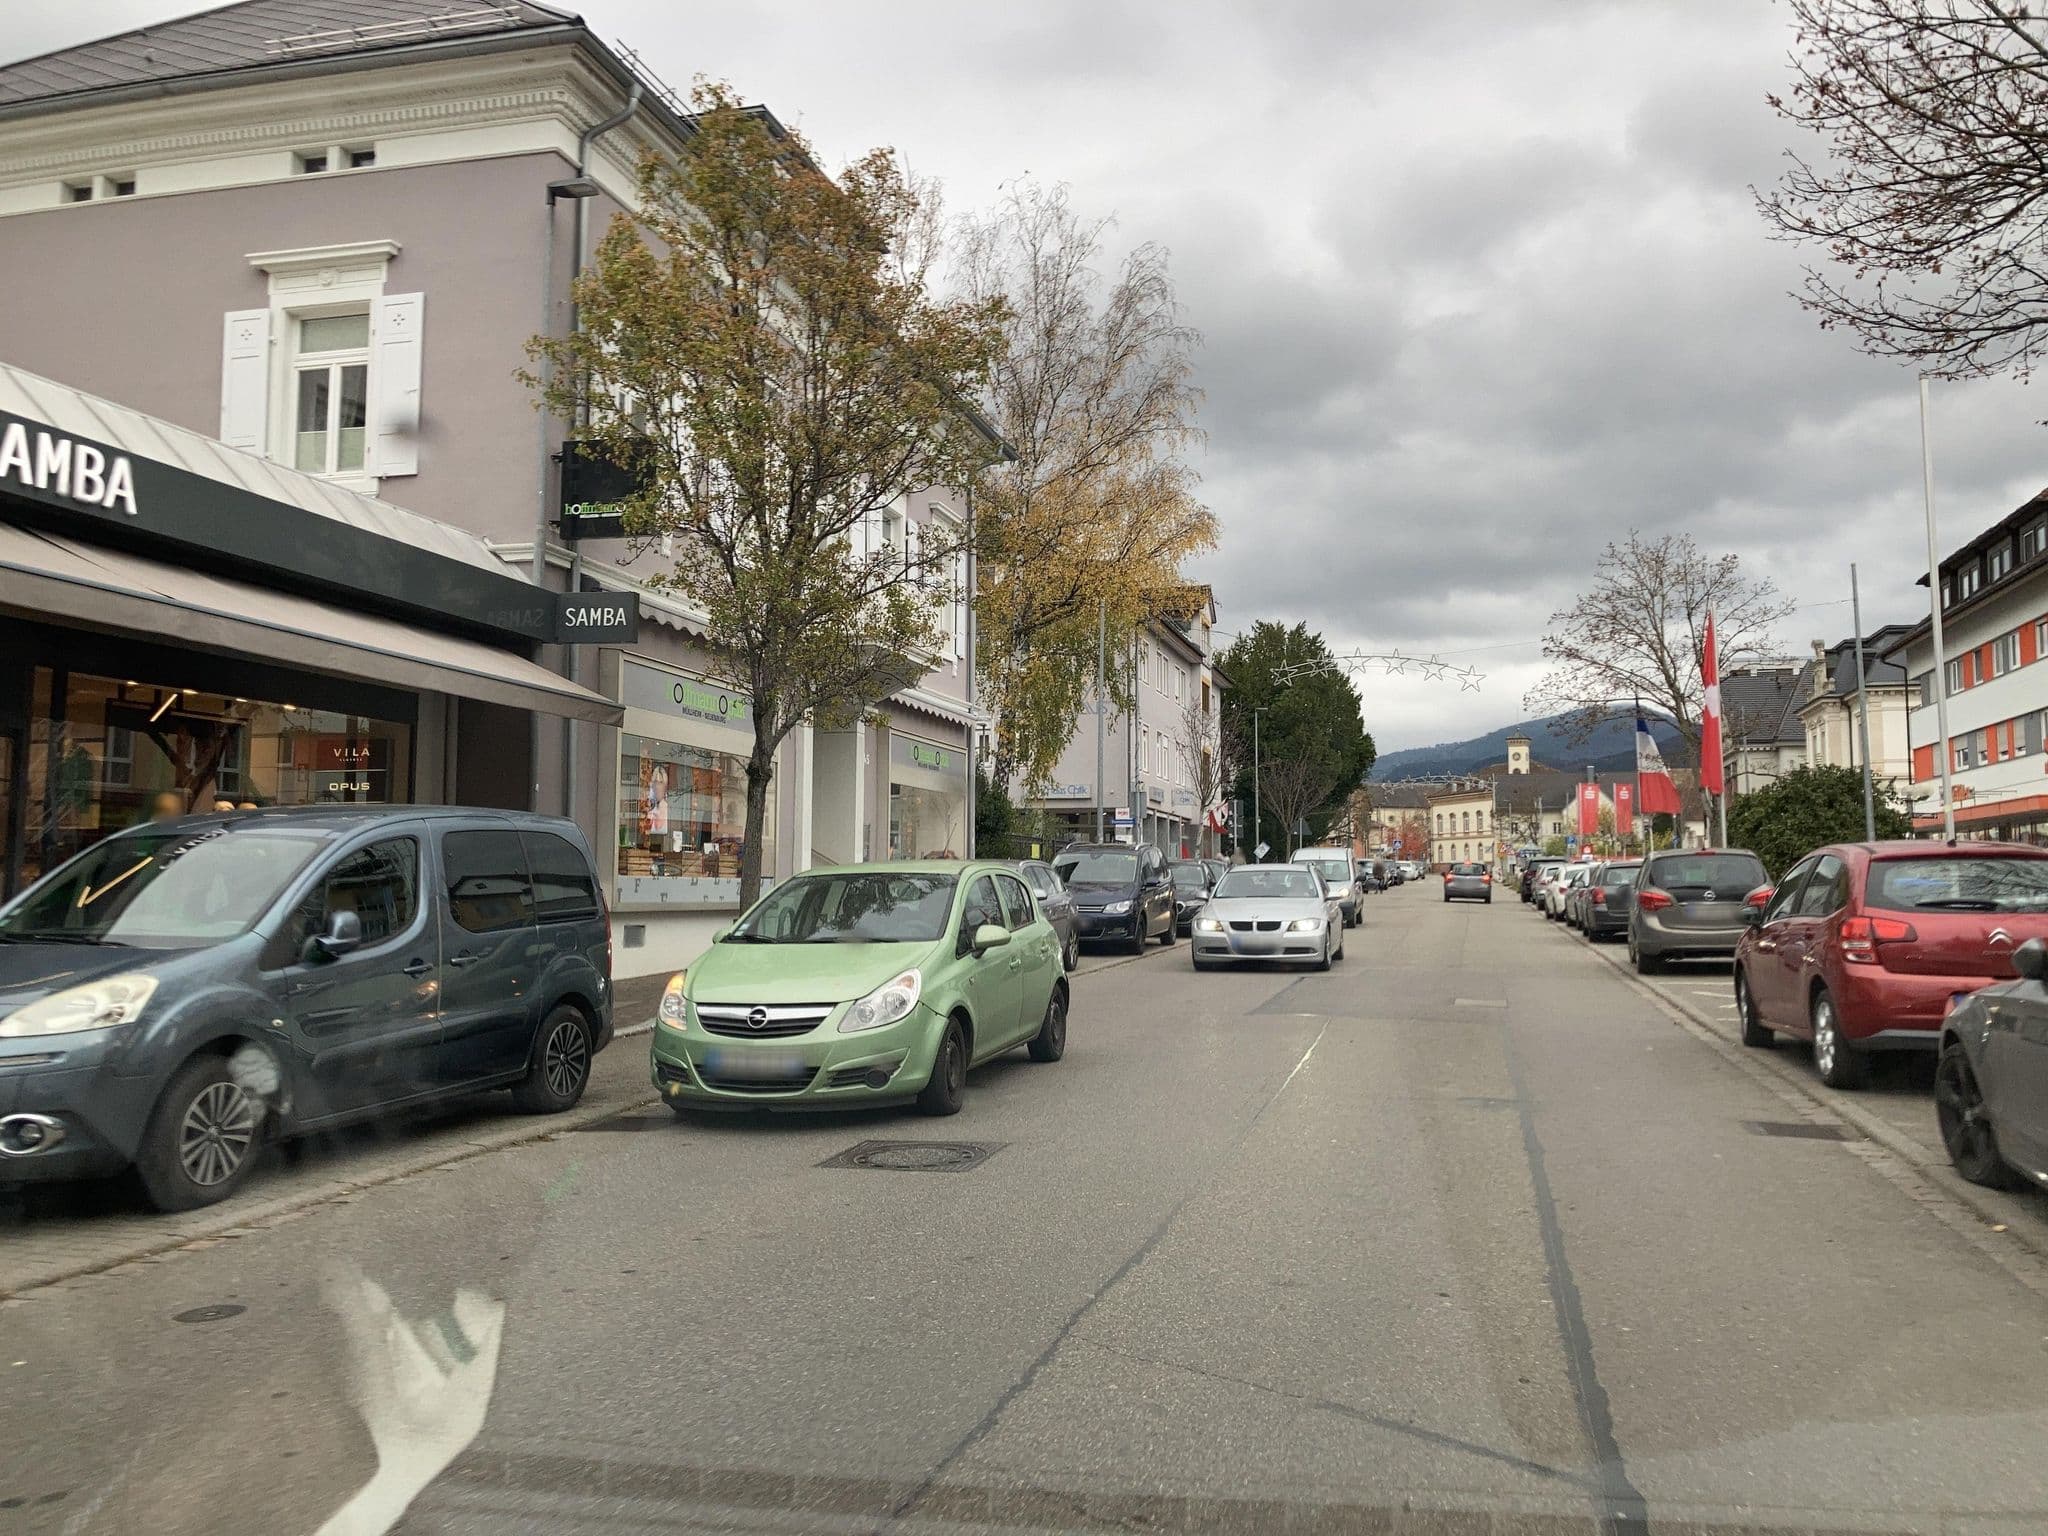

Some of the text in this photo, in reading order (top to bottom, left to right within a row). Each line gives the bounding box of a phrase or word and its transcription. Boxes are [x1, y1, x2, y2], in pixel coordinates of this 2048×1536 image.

[565, 607, 627, 627] SAMBA
[333, 747, 370, 757] VILA
[329, 782, 370, 791] OPUS
